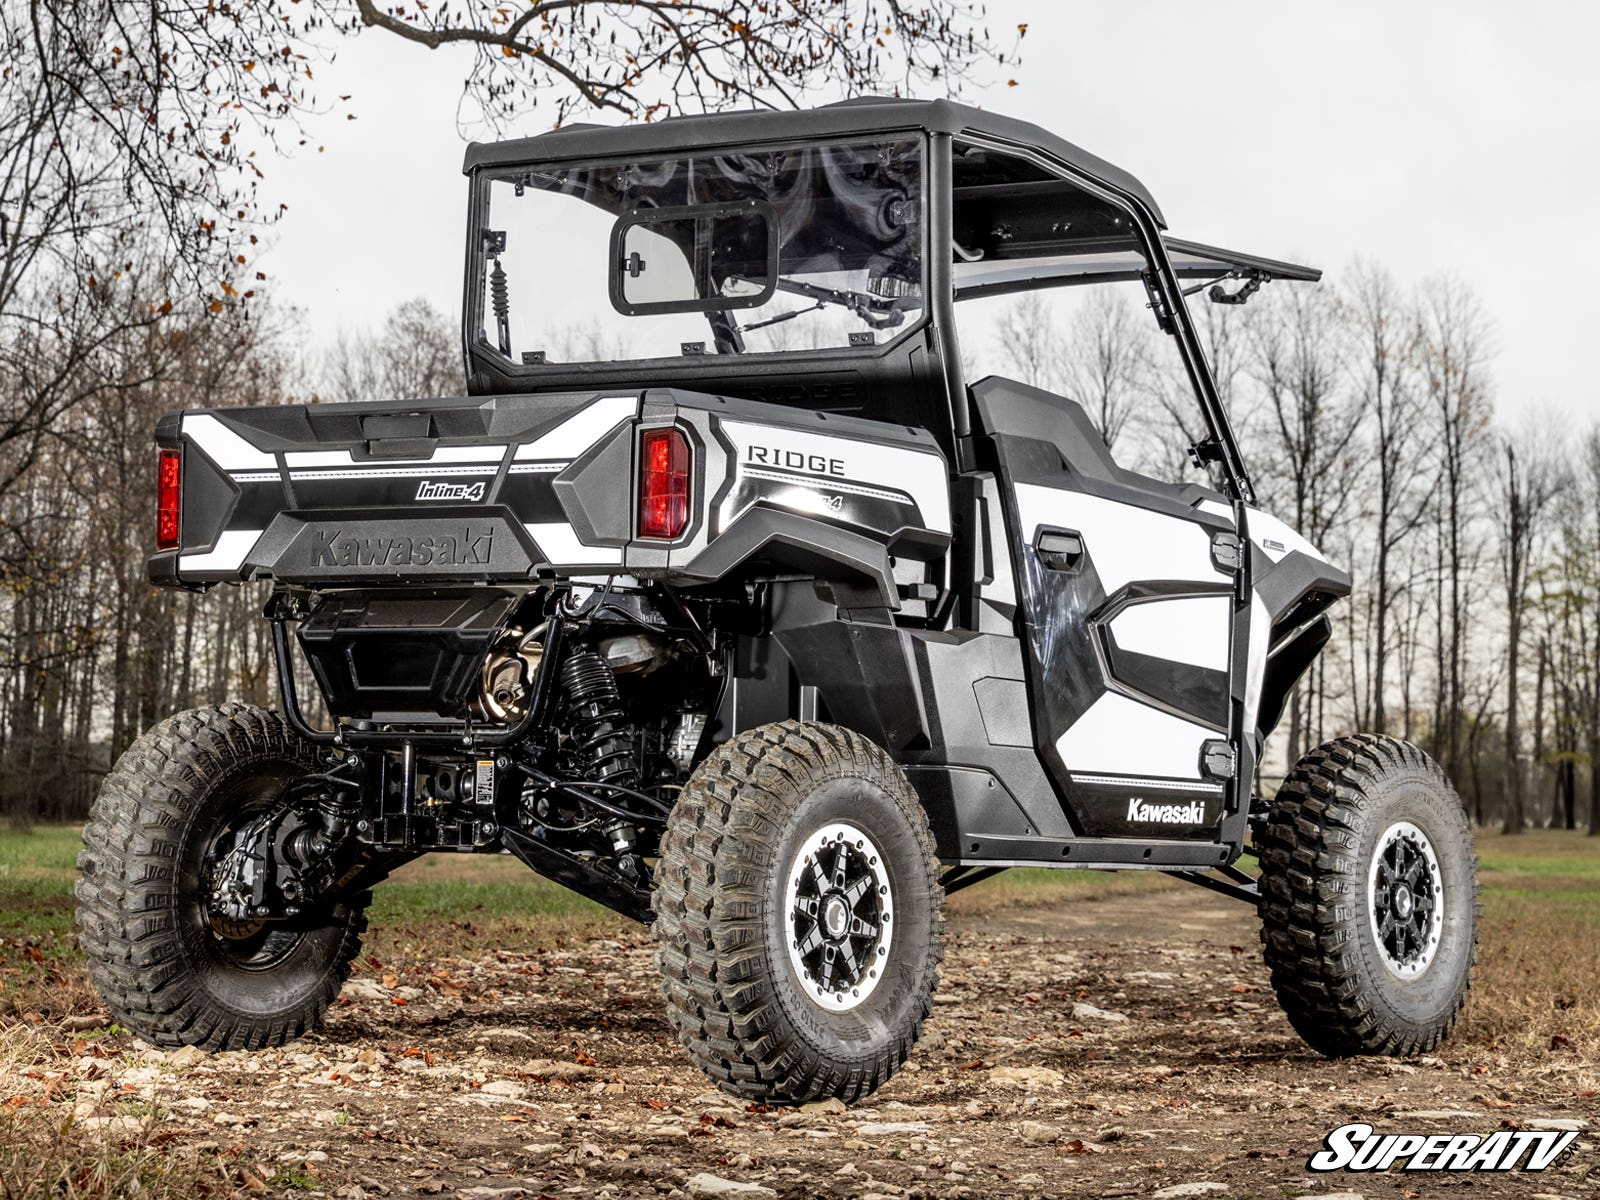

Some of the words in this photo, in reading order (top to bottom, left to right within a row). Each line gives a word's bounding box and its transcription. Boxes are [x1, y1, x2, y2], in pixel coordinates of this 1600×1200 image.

[748, 445, 845, 476] RIDGE
[415, 481, 486, 501] Inline-4
[311, 526, 494, 567] Kawasaki
[1127, 798, 1205, 824] Kawasaki
